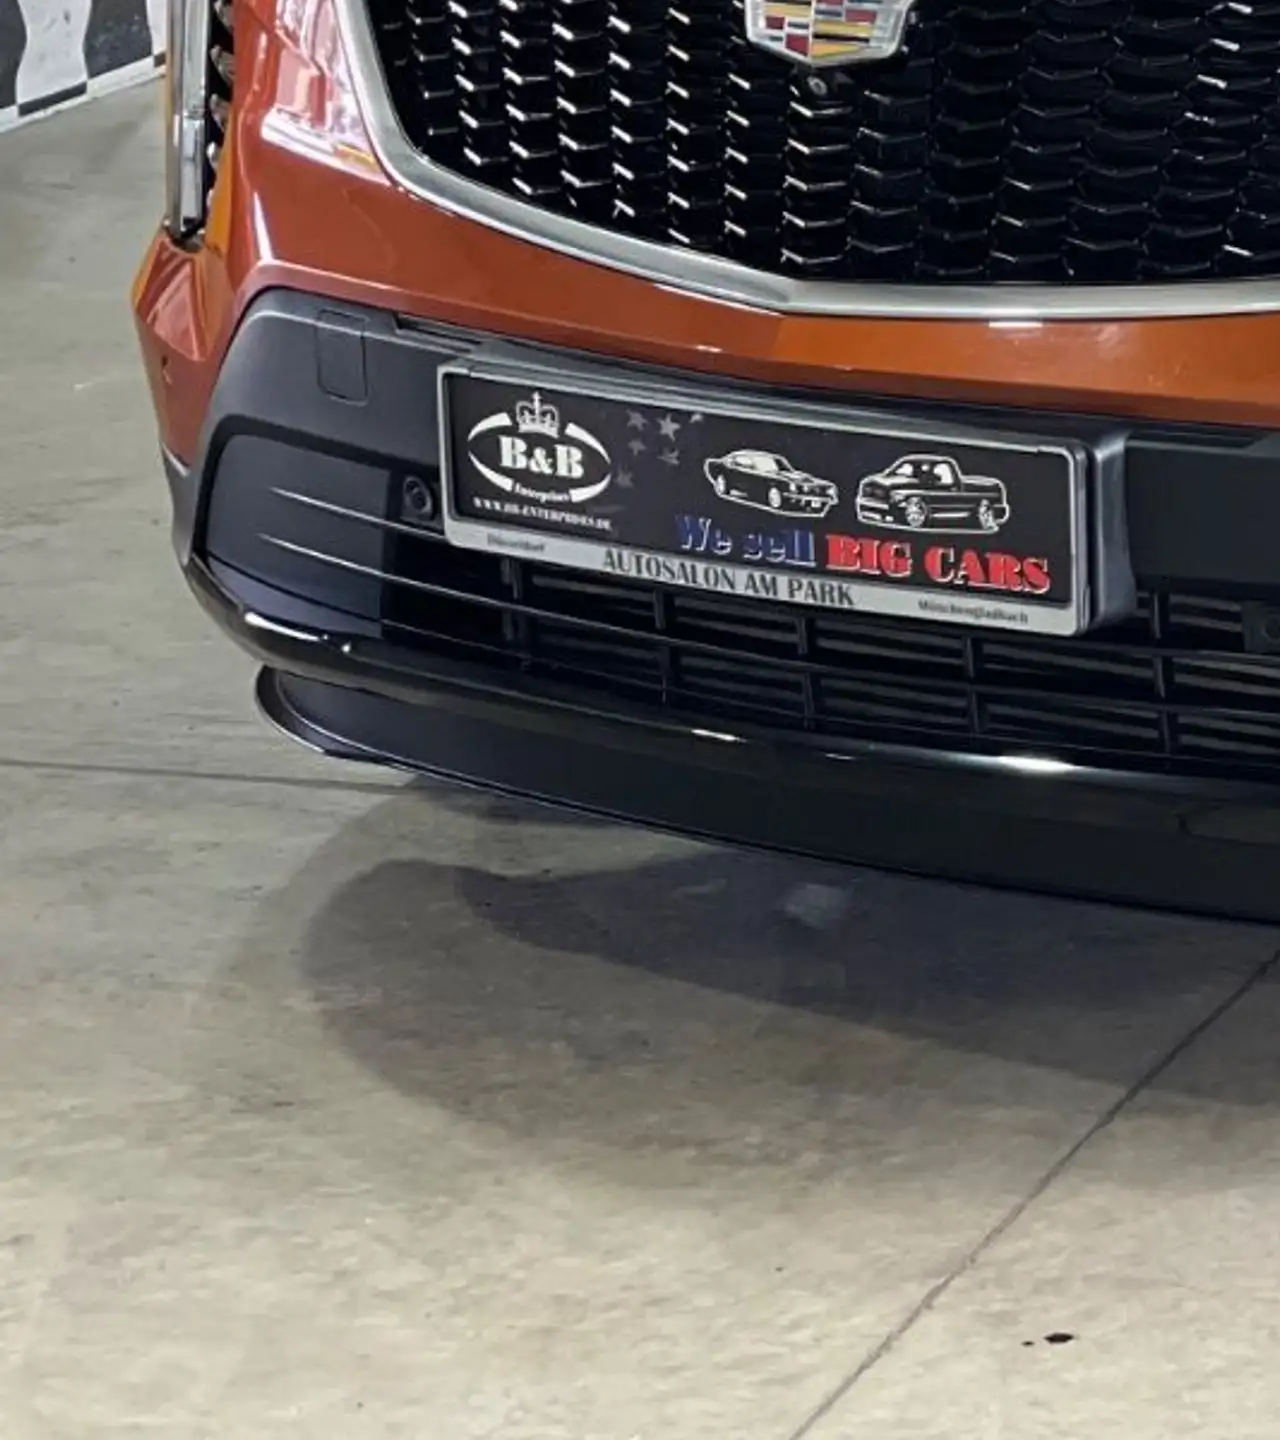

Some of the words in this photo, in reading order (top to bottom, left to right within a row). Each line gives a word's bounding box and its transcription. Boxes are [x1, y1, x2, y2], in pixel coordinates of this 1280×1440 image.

[499, 434, 585, 480] B&B
[602, 547, 737, 592] AUTOSALON
[743, 572, 779, 598] AM
[787, 577, 856, 607] PARK
[675, 514, 732, 555] We
[742, 528, 817, 568] sell
[825, 532, 913, 580] BIG
[923, 544, 1052, 596] CARS
